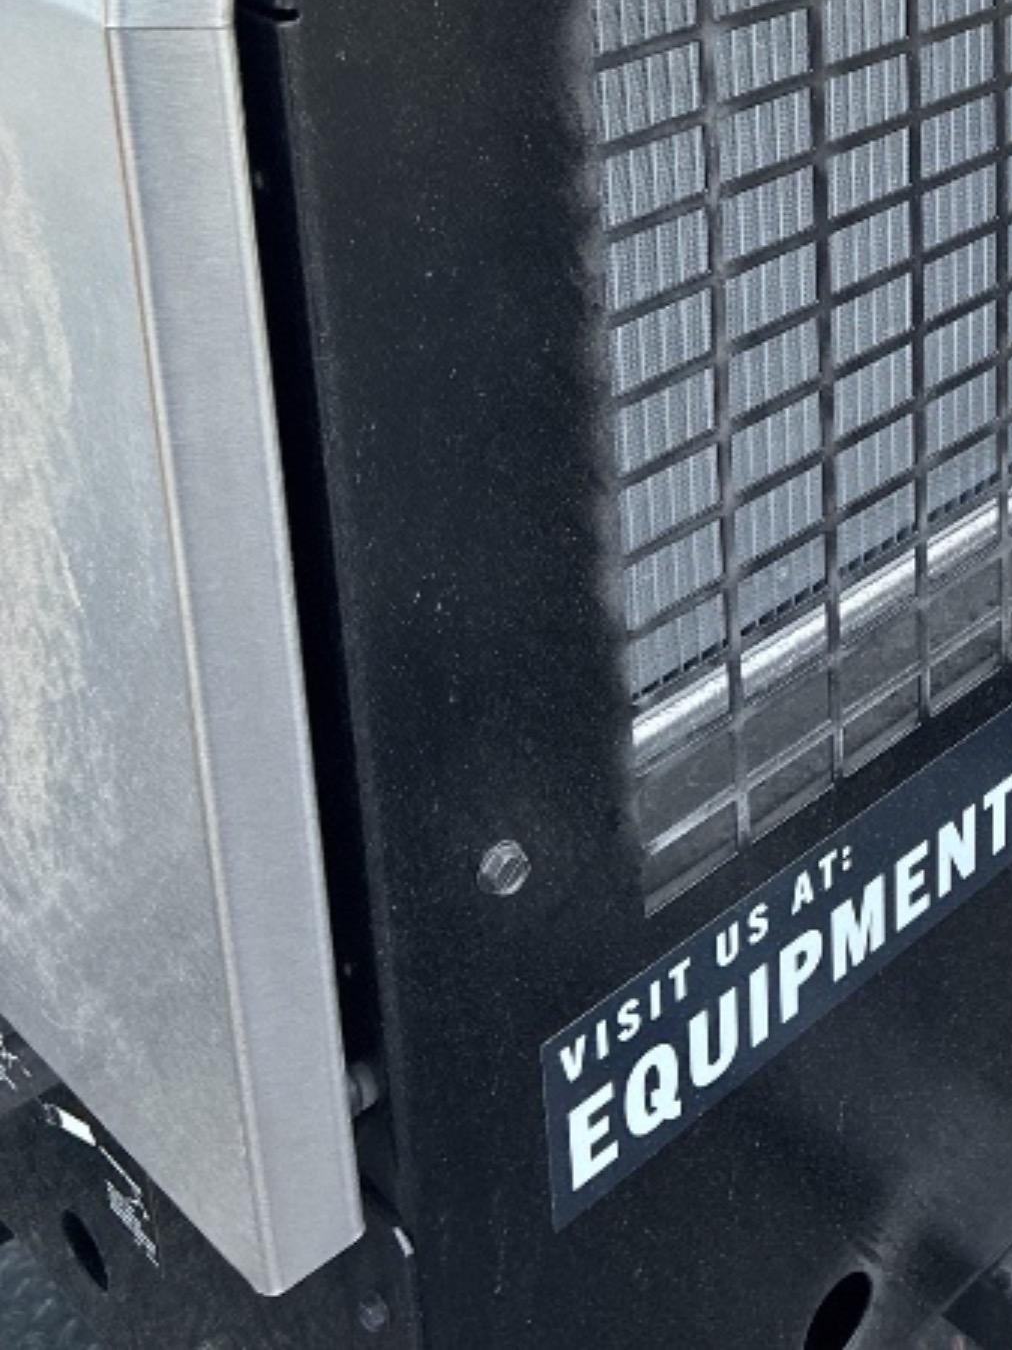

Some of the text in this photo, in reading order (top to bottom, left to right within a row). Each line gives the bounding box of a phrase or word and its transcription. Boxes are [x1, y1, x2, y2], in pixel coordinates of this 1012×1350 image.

[559, 845, 853, 1082] VISIT US AT:
